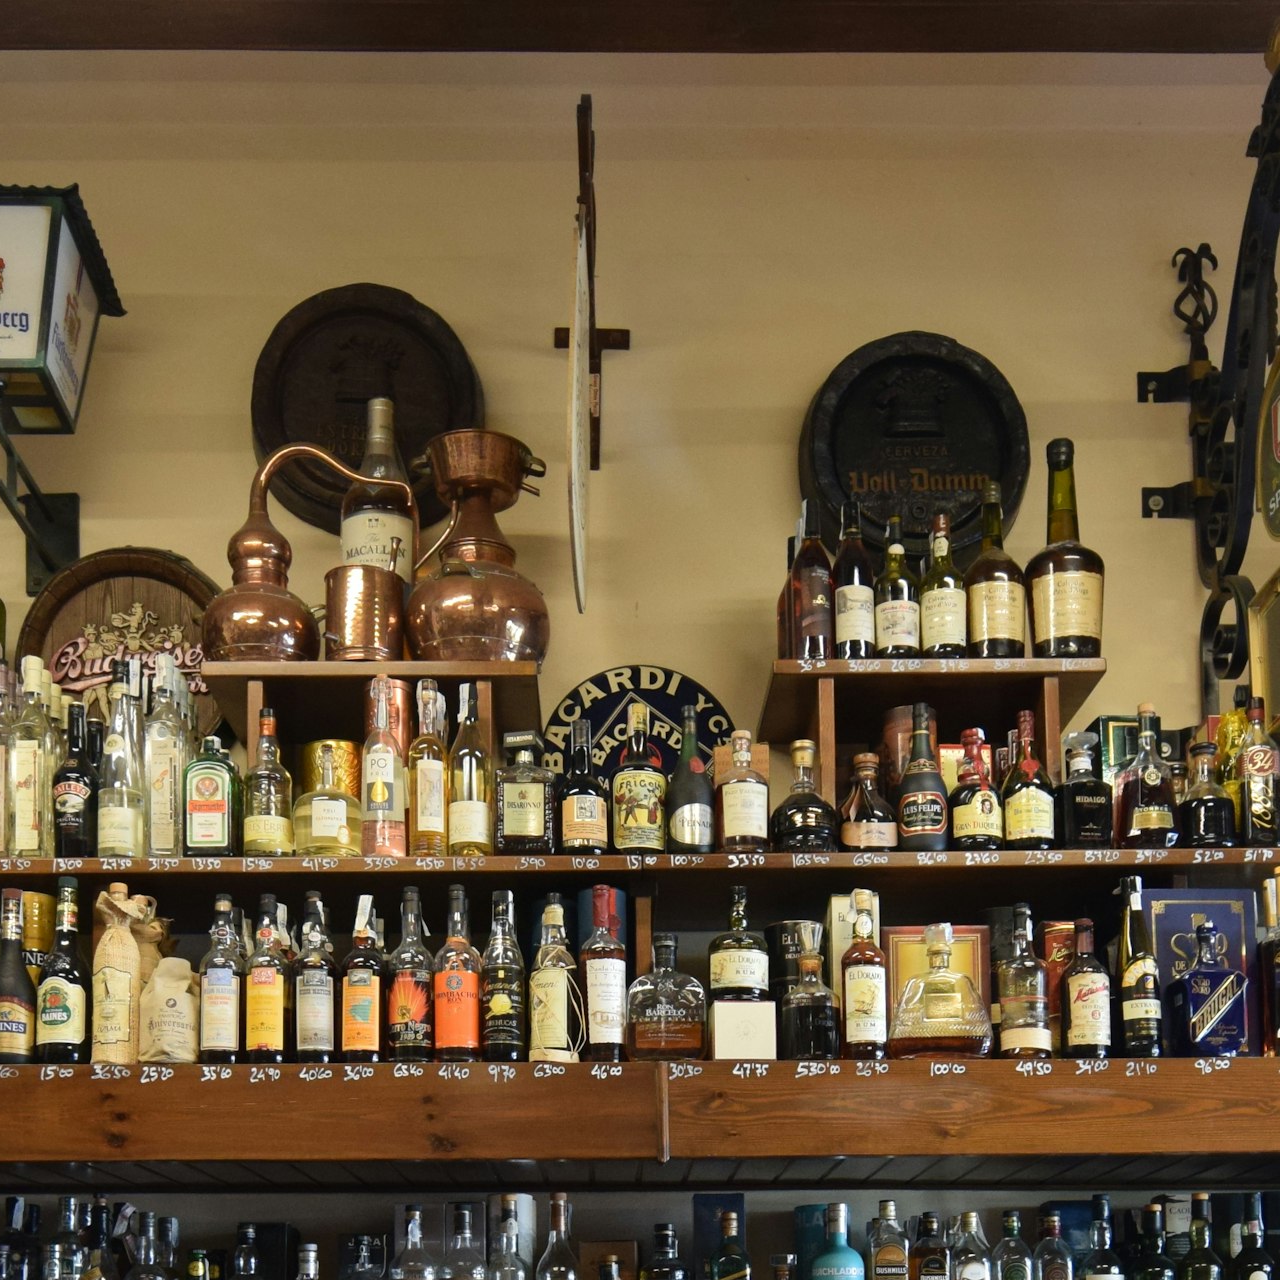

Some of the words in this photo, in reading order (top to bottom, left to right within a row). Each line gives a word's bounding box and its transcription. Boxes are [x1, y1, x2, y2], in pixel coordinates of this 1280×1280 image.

[884, 446, 950, 457] CERVEZA
[542, 666, 682, 774] BACARDI
[695, 693, 713, 713] Y
[1248, 751, 1276, 770] 34
[54, 784, 91, 798] BAILEYS
[506, 801, 541, 810] DISARONNO
[1075, 796, 1106, 804] HIDALGO
[903, 806, 920, 815] LUIS
[922, 804, 942, 814] FELIPE
[728, 856, 765, 867] 33'50
[1244, 850, 1274, 862] 51'70
[53, 859, 82, 872] 13'00
[646, 1008, 686, 1017] BARCELÓ
[1194, 973, 1244, 1041] BRUGAL
[41, 1012, 69, 1021] BAINES
[40, 1066, 74, 1080] 15'00
[344, 1067, 374, 1081] 36'00
[439, 1067, 469, 1080] 41'40
[488, 1067, 515, 1081] 9'70
[534, 1065, 566, 1078] 63'00
[795, 1063, 840, 1077] 530'00
[930, 1061, 966, 1076] 100'00
[1126, 1062, 1157, 1076] 21'10
[1194, 1059, 1229, 1075] 96'00
[250, 1067, 281, 1082] 24'90
